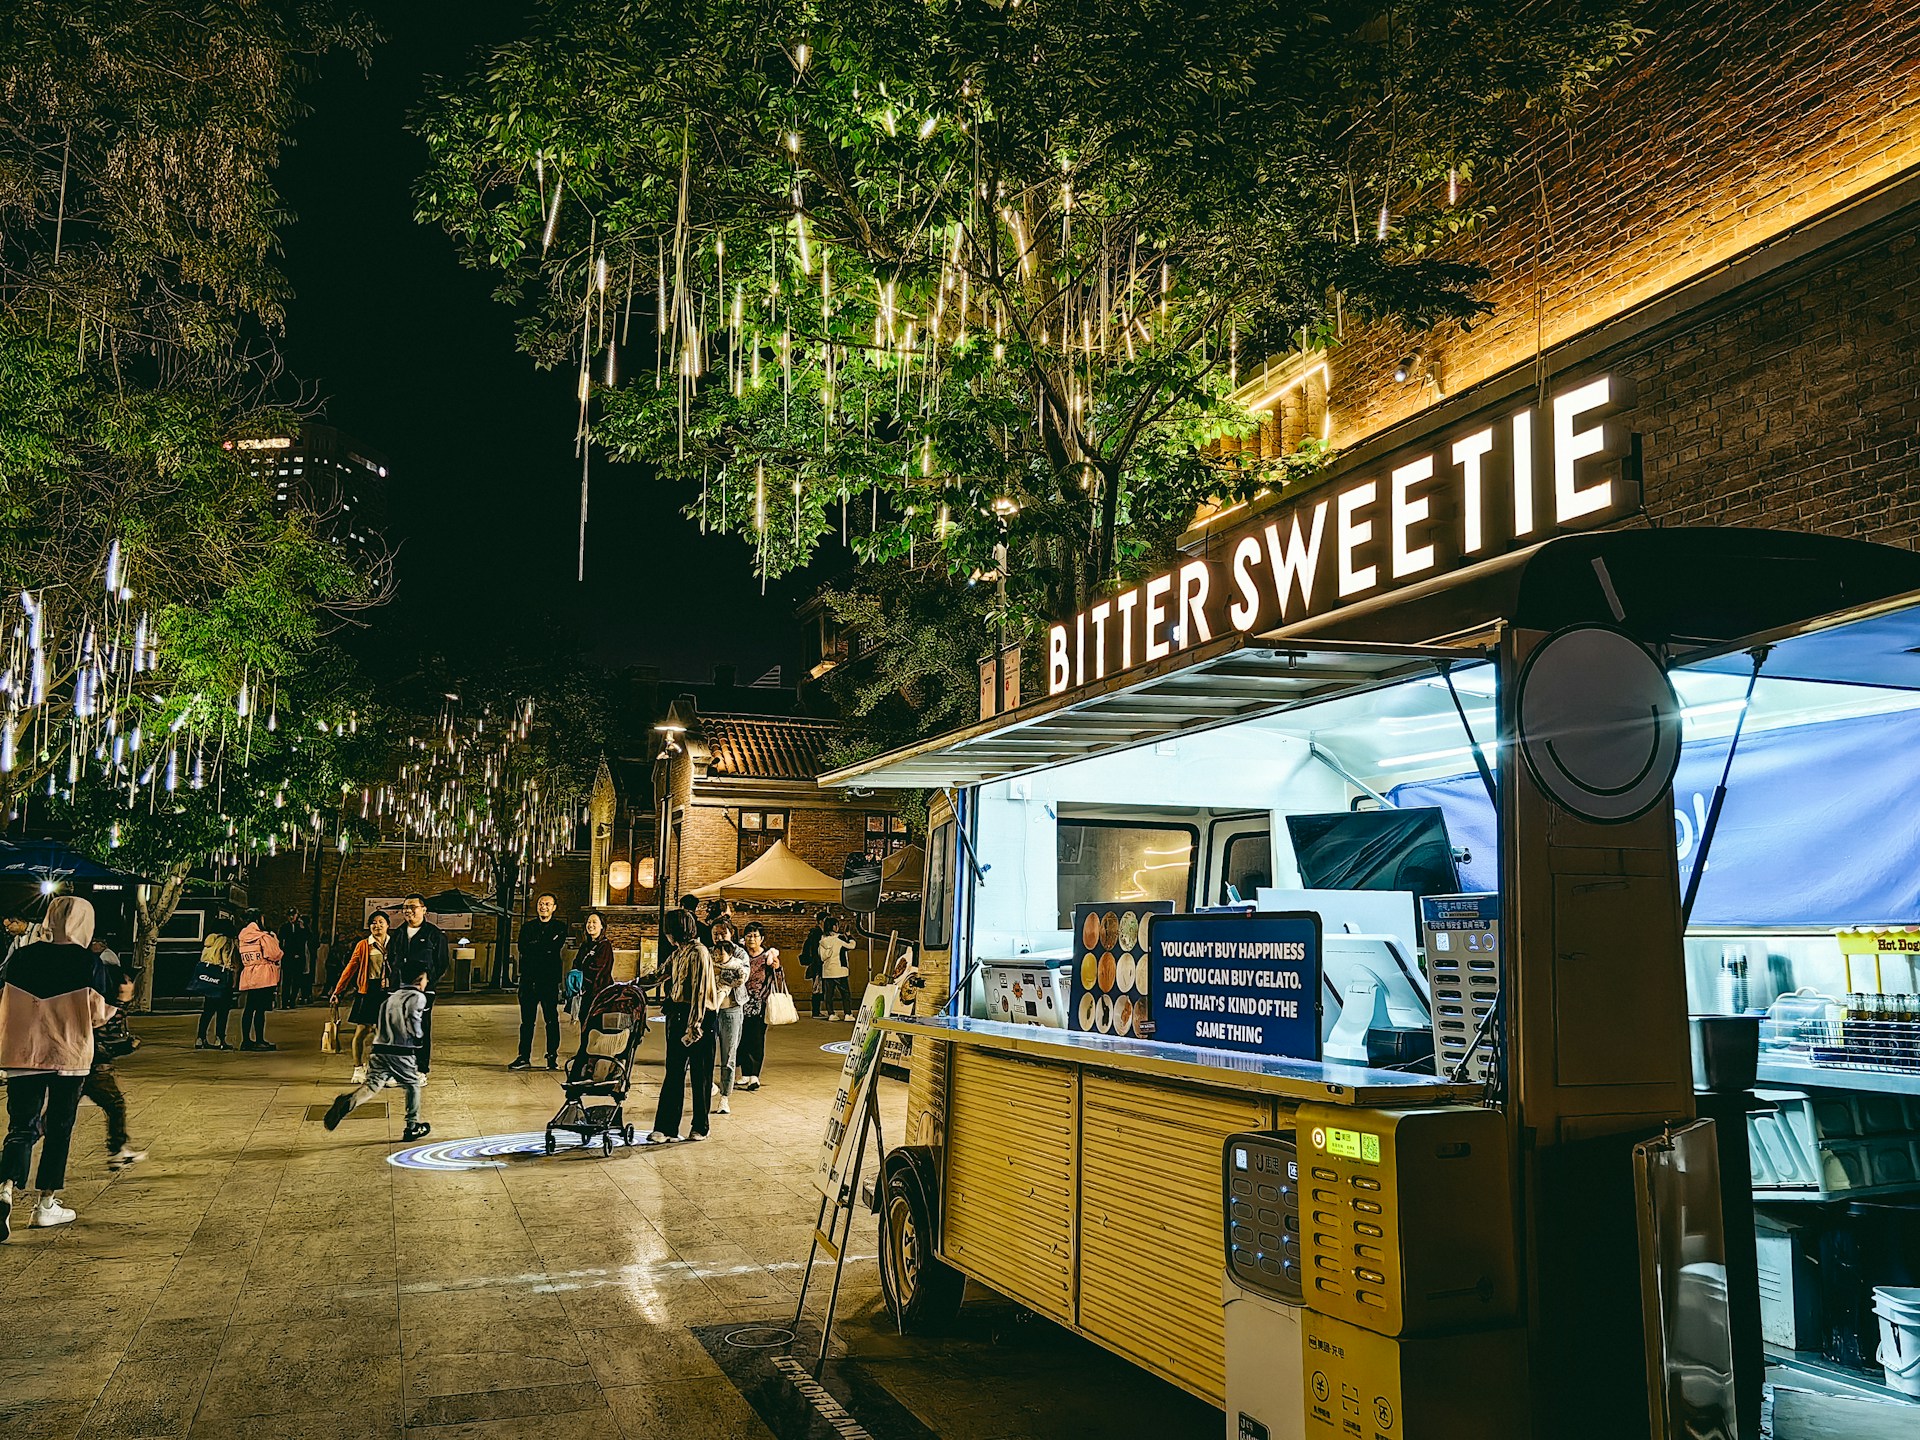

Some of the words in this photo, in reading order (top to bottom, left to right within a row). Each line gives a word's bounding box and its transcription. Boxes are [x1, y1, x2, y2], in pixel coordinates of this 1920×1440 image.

[1048, 560, 1211, 695] BITTER
[1230, 376, 1613, 632] SWEETIE
[1161, 942, 1182, 957] YOU
[1215, 942, 1238, 959] BUY
[1239, 943, 1305, 960] HAPPINESS
[1878, 939, 1897, 950] Hot
[1898, 939, 1920, 951] Dog
[1164, 967, 1184, 983] BUT
[1186, 968, 1207, 984] YOU
[1208, 969, 1230, 985] CAN
[1231, 970, 1254, 987] BUY
[1255, 971, 1302, 990] GELATO.
[1165, 993, 1188, 1009] AND
[1228, 997, 1257, 1015] KIND
[1258, 999, 1274, 1016] OF
[1274, 1000, 1298, 1018] THE
[1196, 1021, 1226, 1039] SAME
[1227, 1024, 1263, 1044] THING
[794, 1380, 849, 1418] COFFEE
